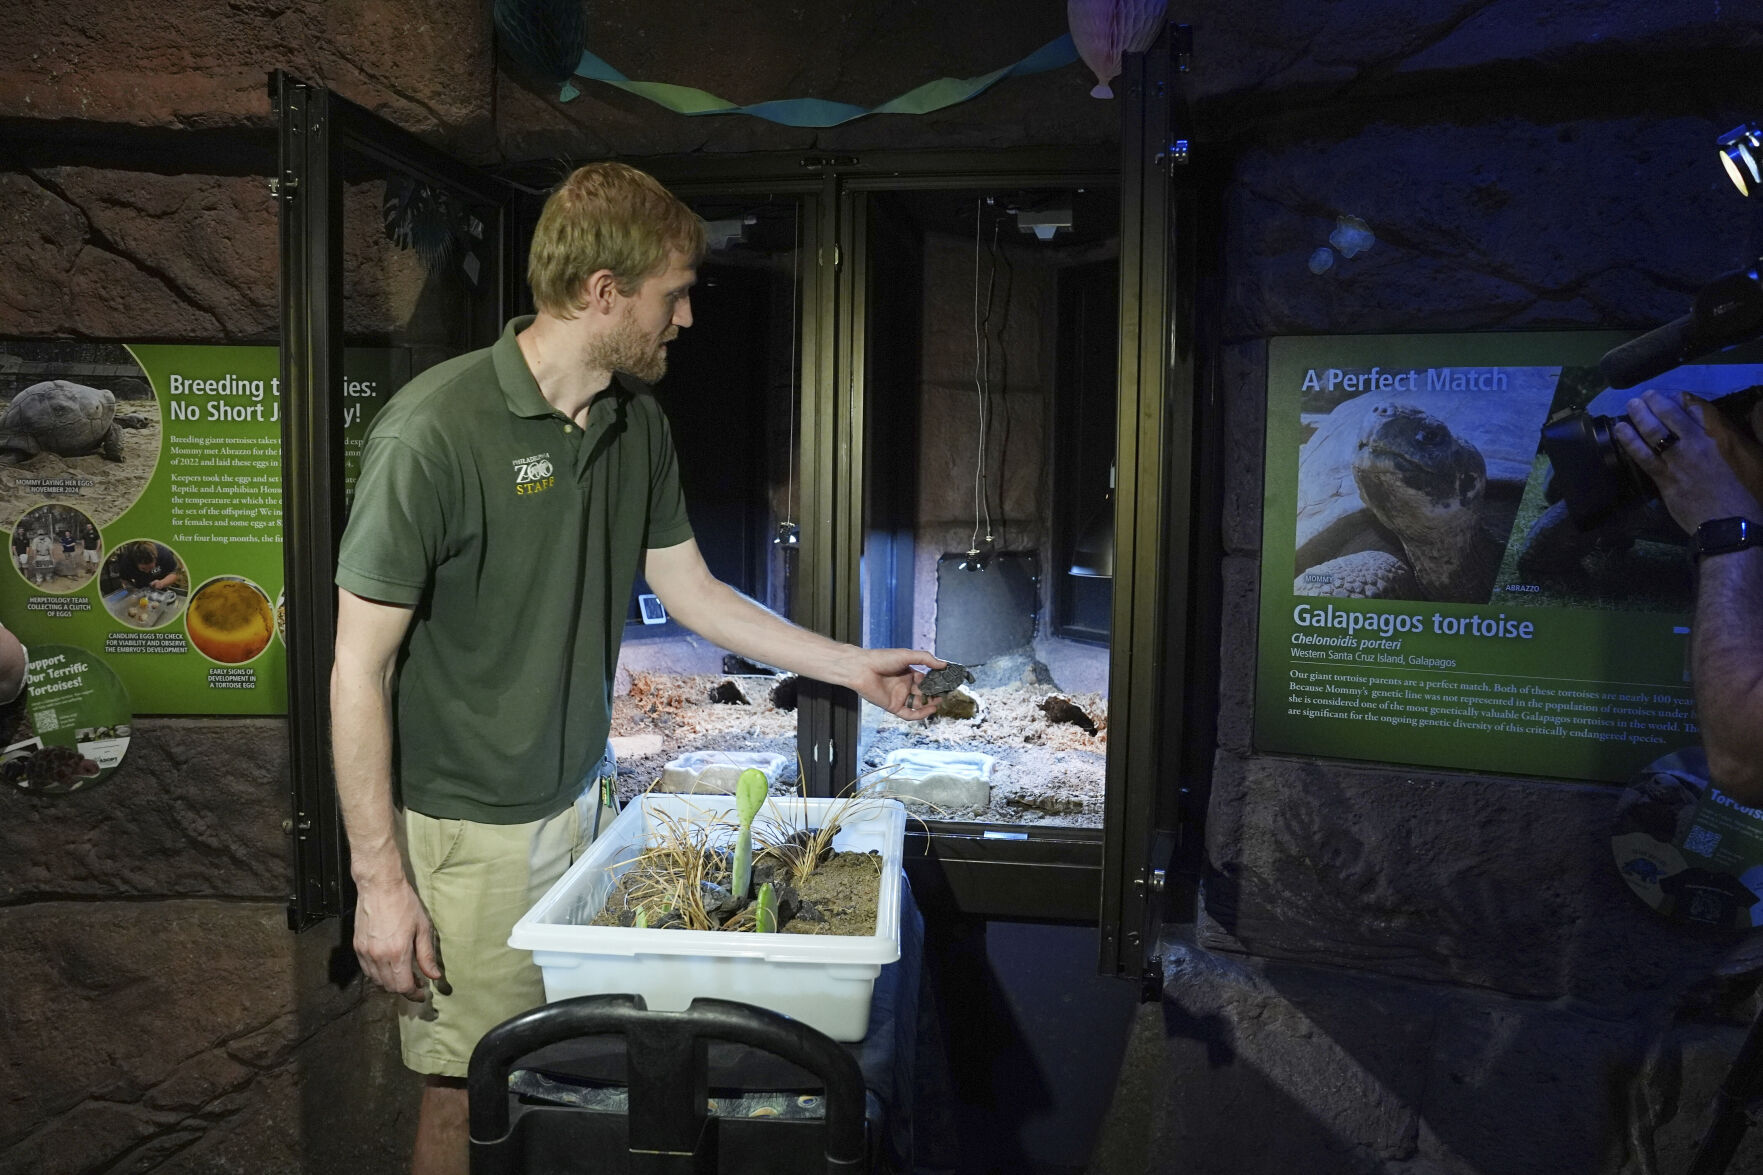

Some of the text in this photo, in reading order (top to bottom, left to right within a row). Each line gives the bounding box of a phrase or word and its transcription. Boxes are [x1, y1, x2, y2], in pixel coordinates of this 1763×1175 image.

[169, 374, 264, 401] Breeding
[1301, 367, 1508, 392] A Perfect Match
[170, 400, 200, 421] No
[207, 400, 264, 422] Short
[170, 435, 204, 446] Breeding
[205, 437, 224, 446] giant
[258, 436, 277, 444] takes
[170, 446, 202, 456] Mommy
[220, 447, 251, 455] Abrazzo
[253, 447, 264, 455] for
[170, 457, 278, 469] of 2022 and laid these eggs in
[514, 459, 554, 483] ZOO
[171, 473, 201, 484] Keepers
[202, 473, 220, 482] took
[221, 474, 233, 482] the
[235, 476, 251, 484] eggs
[252, 474, 267, 482] and
[516, 476, 555, 496] STAFF
[171, 484, 282, 495] Reptile and Amphibian Hous
[171, 496, 183, 504] the
[185, 497, 231, 506] temperature
[241, 496, 264, 504] which
[265, 497, 277, 505] the
[171, 507, 184, 515] the
[198, 507, 208, 515] of
[208, 507, 220, 515] the
[221, 507, 258, 518] offspring!
[171, 518, 183, 526] for
[184, 518, 213, 526] females
[214, 518, 228, 526] and
[250, 521, 266, 529] eggs
[173, 534, 193, 542] After
[193, 534, 210, 542] four
[211, 534, 228, 544] long
[229, 535, 260, 543] months,
[1305, 575, 1333, 584] MOMMY
[1505, 584, 1540, 593] ABRAZZO
[1293, 604, 1534, 639] Galapagos tortoise
[1291, 632, 1402, 651] Chelonoidis porteri
[29, 654, 66, 670] upport
[1290, 647, 1457, 669] Western Santa Cruz Island, Galapagos
[26, 661, 89, 684] Our Terrific
[28, 676, 83, 696] Tortoises!
[1290, 669, 1308, 679] Our
[1309, 672, 1332, 682] giant
[1334, 674, 1368, 683] tortoise
[1369, 677, 1402, 686] parents
[1425, 680, 1458, 690] perfect
[1460, 682, 1491, 692] match.
[1493, 683, 1517, 694] Both
[1519, 685, 1531, 694] of
[1531, 685, 1556, 696] these
[1557, 688, 1600, 699] tortoises
[1619, 693, 1649, 704] nearly
[1652, 694, 1672, 703] 100
[1289, 682, 1324, 692] Because
[1371, 689, 1403, 698] genetic
[1405, 690, 1422, 699] line
[1460, 696, 1514, 706] represented
[1516, 698, 1526, 707] in
[1527, 699, 1543, 708] the
[1545, 701, 1598, 712] population
[1600, 704, 1613, 713] of
[1613, 707, 1657, 716] tortoises
[1658, 708, 1689, 719] under
[1288, 694, 1302, 703] she
[1304, 695, 1311, 703] is
[1312, 697, 1359, 707] considered
[1379, 700, 1391, 709] of
[1390, 702, 1404, 711] the
[1406, 704, 1428, 713] most
[1429, 707, 1479, 719] genetically
[1481, 708, 1519, 719] valuable
[1521, 711, 1570, 726] Galapagos
[1572, 717, 1615, 727] tortoises
[1616, 719, 1627, 728] in
[1629, 719, 1646, 729] the
[1648, 721, 1680, 732] world.
[1302, 708, 1348, 719] significant
[1350, 710, 1363, 720] for
[1364, 712, 1378, 721] the
[1380, 716, 1418, 727] ongoing
[1418, 719, 1451, 728] genetic
[1452, 718, 1492, 733] diversity
[1494, 722, 1506, 731] of
[1505, 722, 1524, 733] this
[1525, 726, 1568, 739] critically
[1569, 728, 1627, 742] endangered
[1628, 734, 1667, 744] species.
